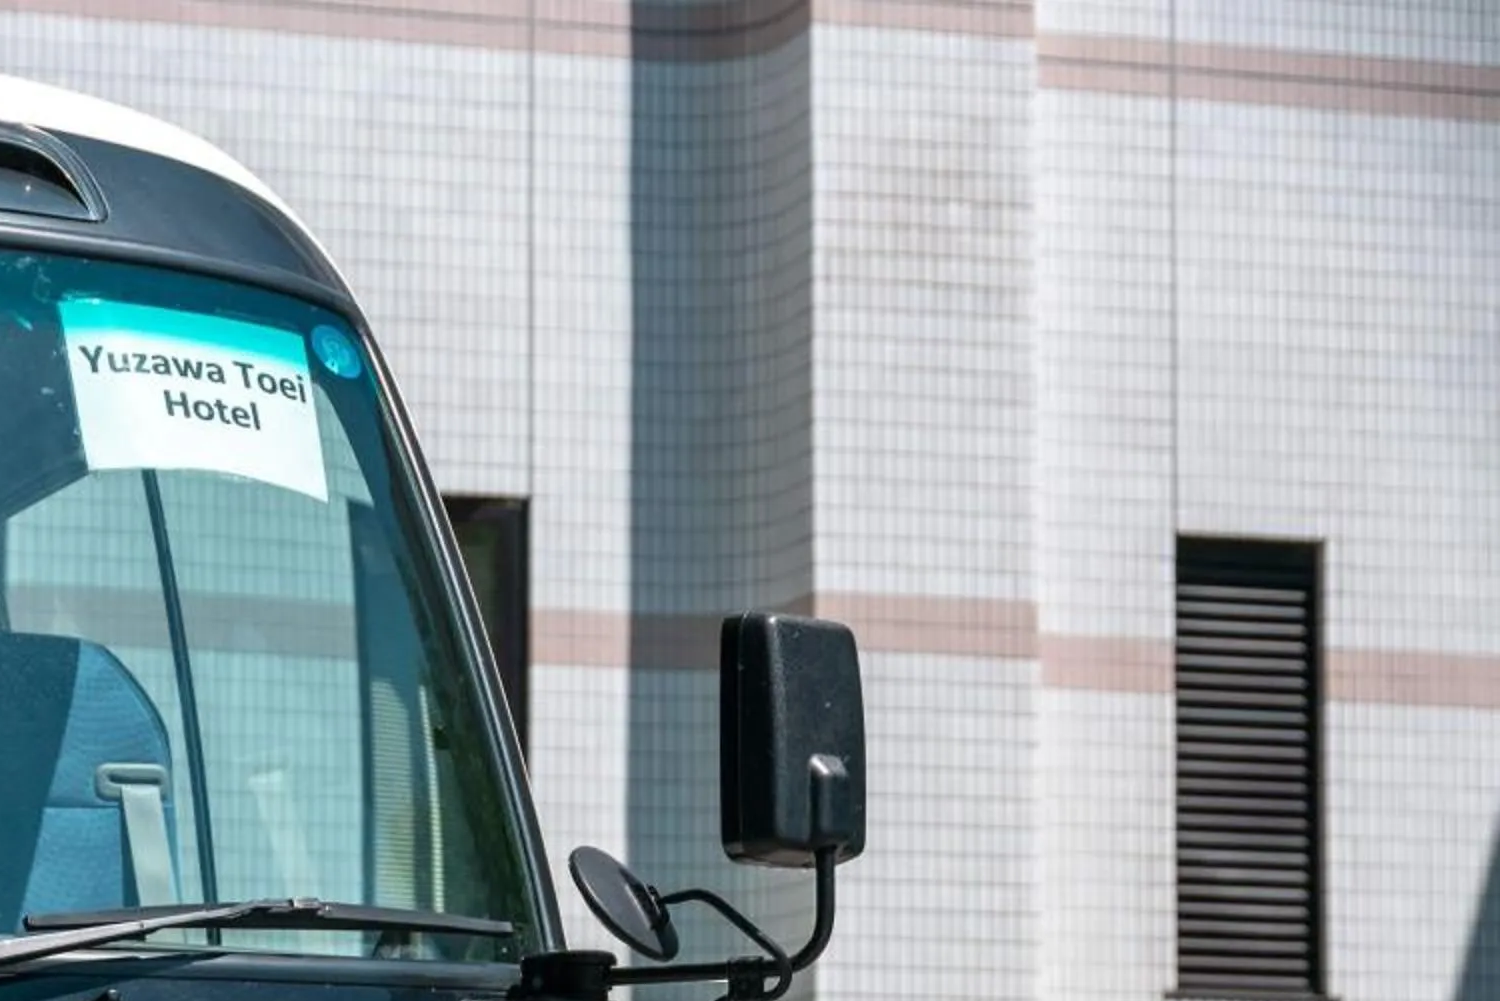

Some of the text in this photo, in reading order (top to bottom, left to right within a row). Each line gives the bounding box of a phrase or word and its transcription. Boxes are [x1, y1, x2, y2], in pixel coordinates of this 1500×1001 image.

[79, 345, 307, 404] Yuzawa Toei
[164, 389, 261, 431] Hotel
